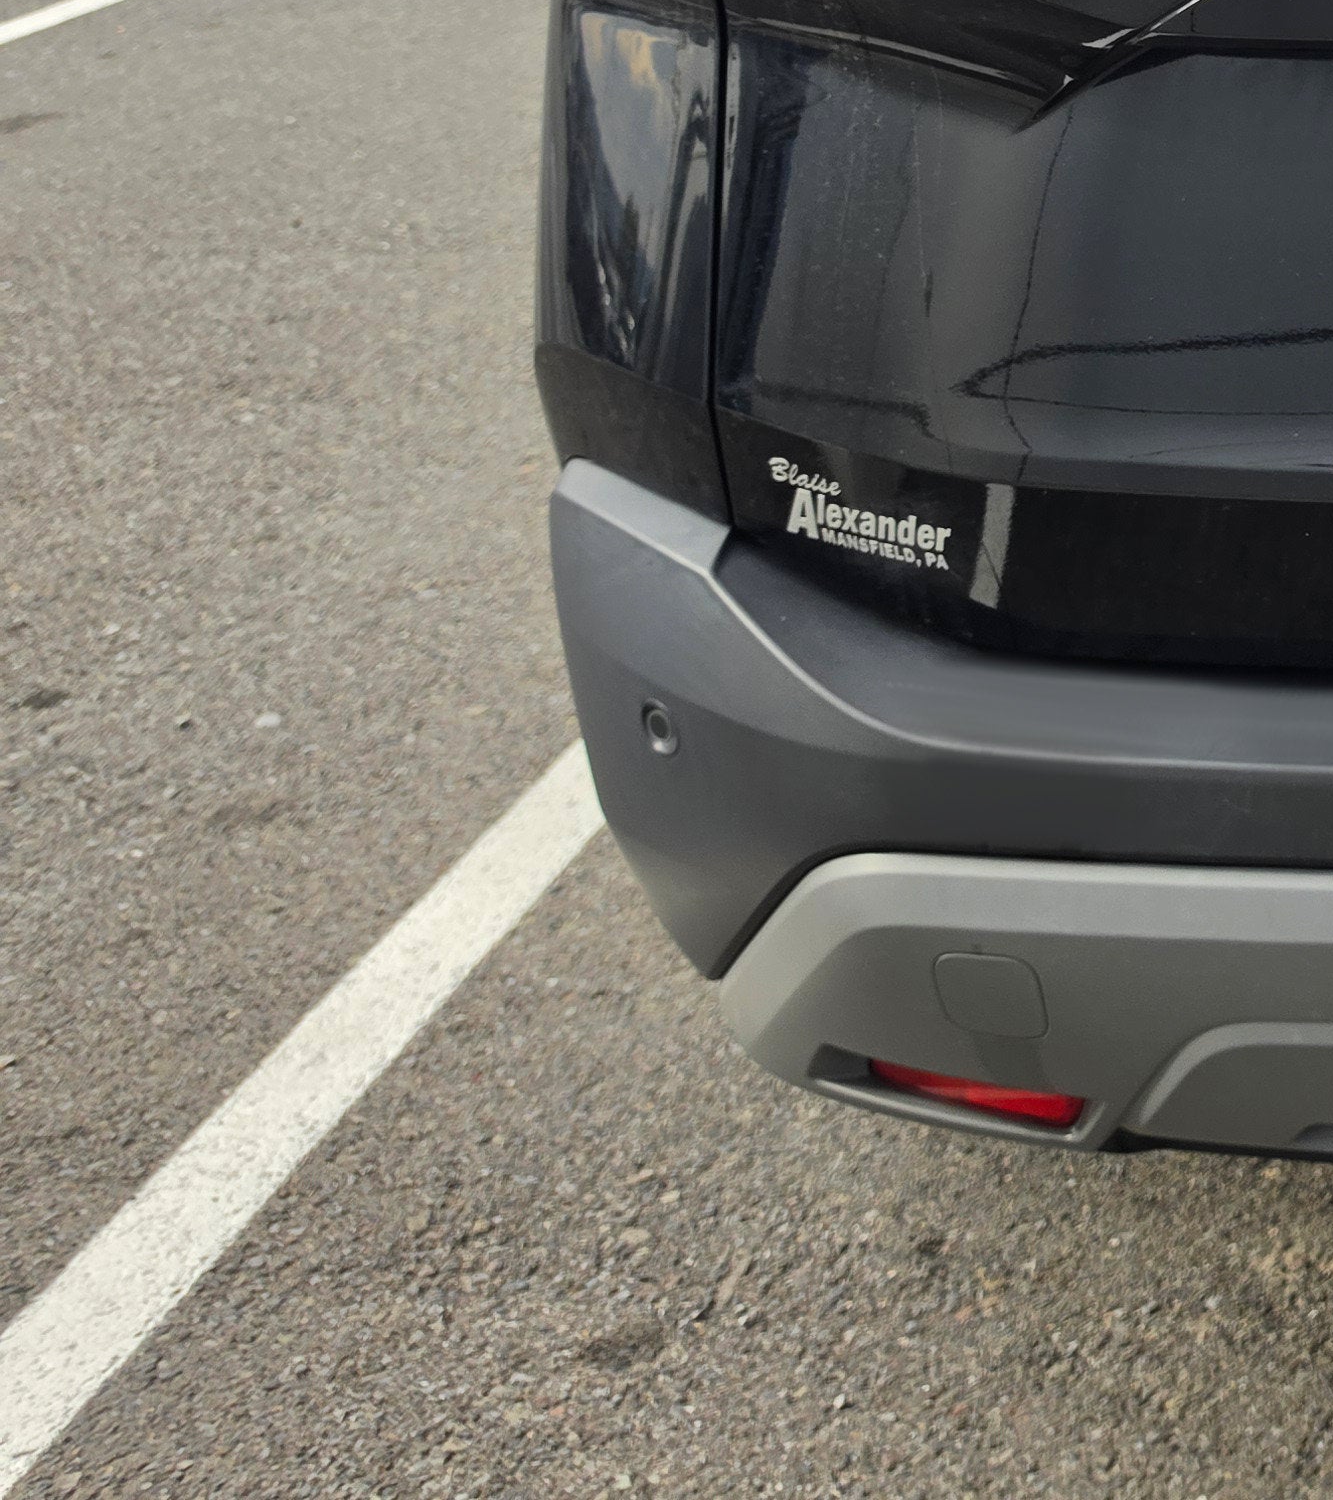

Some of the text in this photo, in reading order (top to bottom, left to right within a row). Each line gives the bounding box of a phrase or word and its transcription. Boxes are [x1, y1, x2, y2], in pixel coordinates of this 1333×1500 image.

[768, 456, 842, 497] Blaise
[786, 487, 952, 552] Alexander
[821, 527, 950, 571] MANSFIELD, PA
